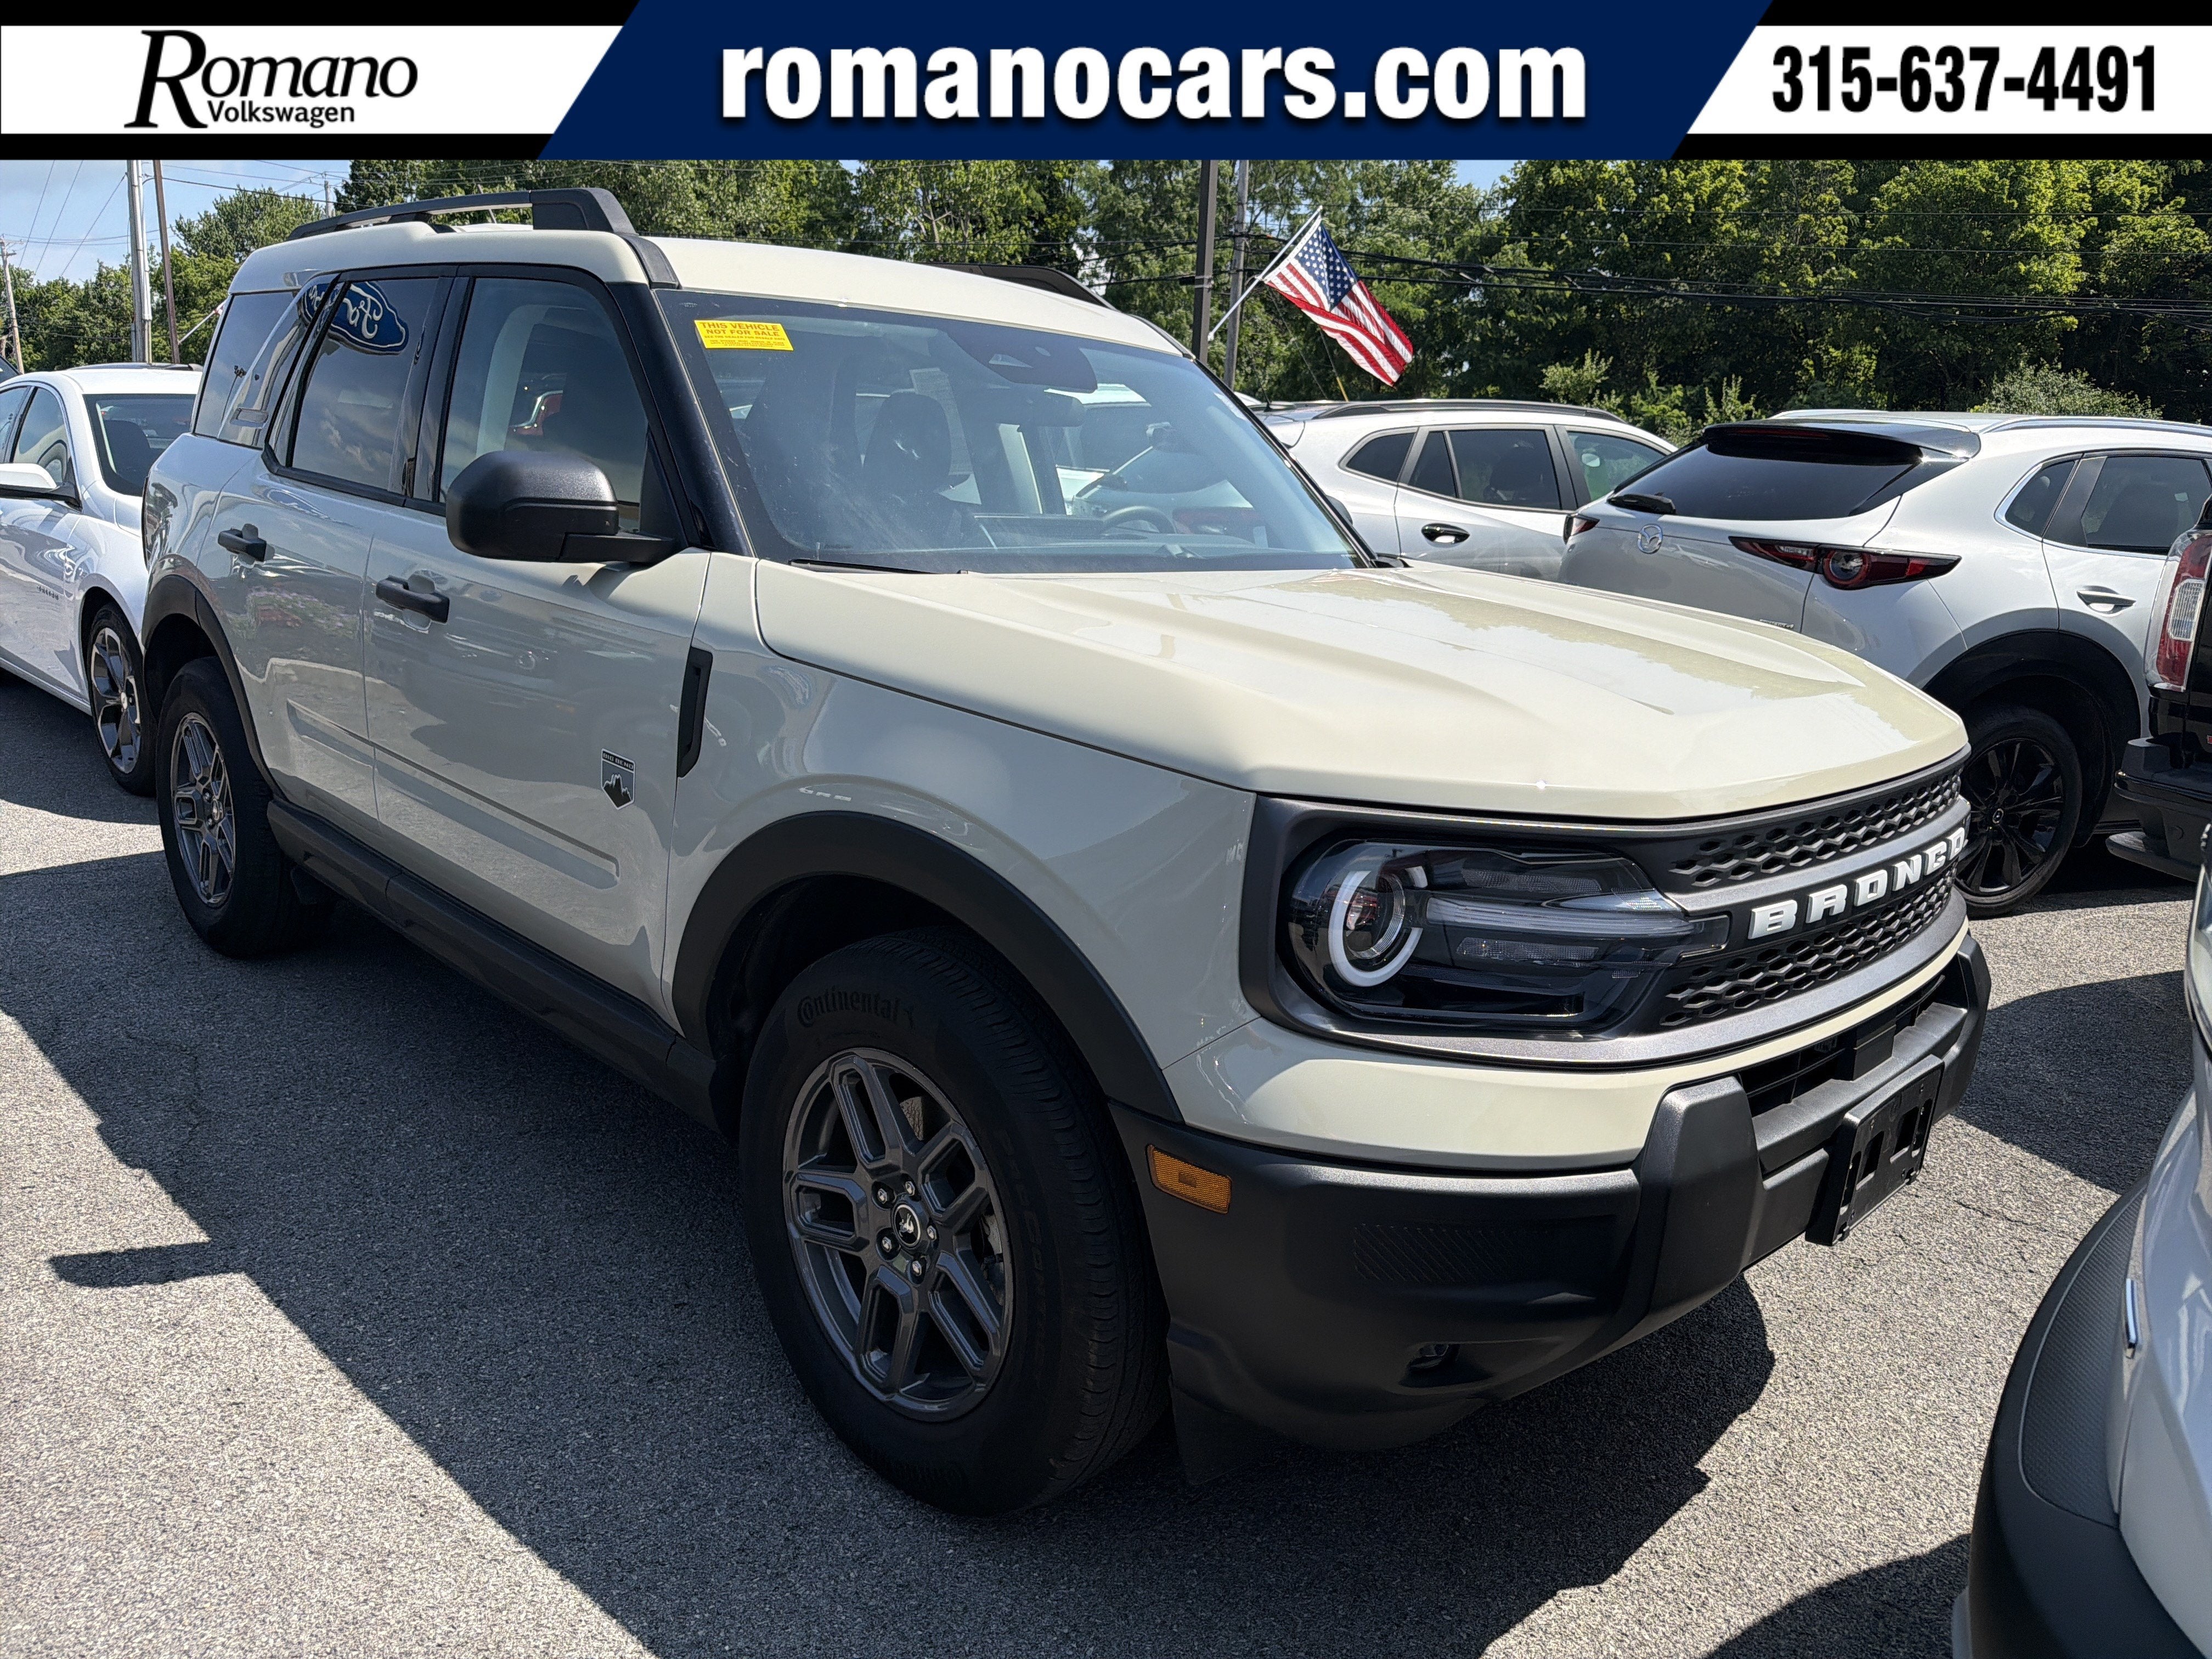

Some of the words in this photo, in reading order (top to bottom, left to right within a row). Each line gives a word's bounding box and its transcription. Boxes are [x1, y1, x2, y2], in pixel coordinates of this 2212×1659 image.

[730, 323, 780, 331] VEHICLE
[603, 753, 614, 761] BIG
[615, 758, 634, 769] BEND
[1748, 827, 1966, 939] BRONCO
[797, 985, 900, 1028] Continental
